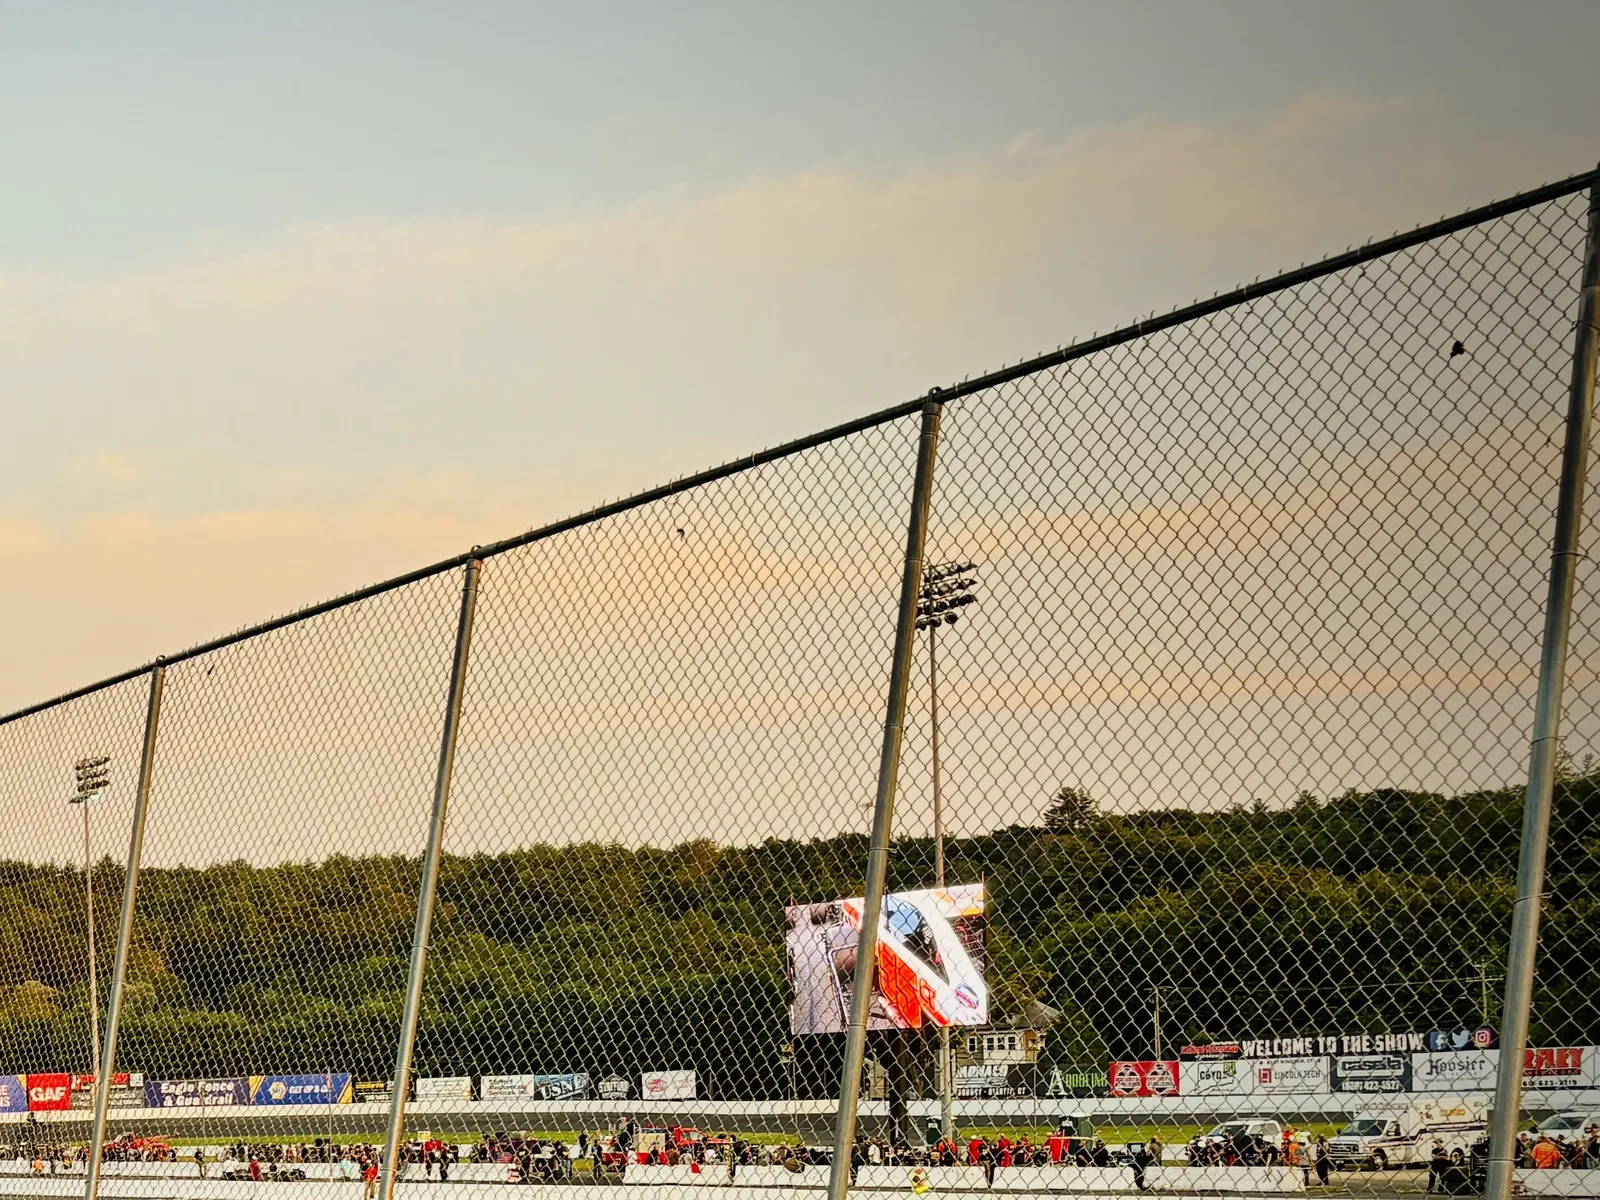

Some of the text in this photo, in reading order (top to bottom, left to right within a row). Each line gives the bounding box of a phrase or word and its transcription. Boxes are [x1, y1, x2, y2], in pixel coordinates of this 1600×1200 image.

[1242, 1037, 1316, 1057] WELCOME
[1317, 1035, 1337, 1053] TO
[1341, 1034, 1374, 1053] THE
[1375, 1032, 1425, 1052] SHOW
[956, 1064, 1009, 1079] MONACO
[1426, 1056, 1485, 1076] Hoosier
[30, 1086, 67, 1102] GAF
[160, 1081, 234, 1095] Eagle Fence
[176, 1093, 233, 1106] Guadrail
